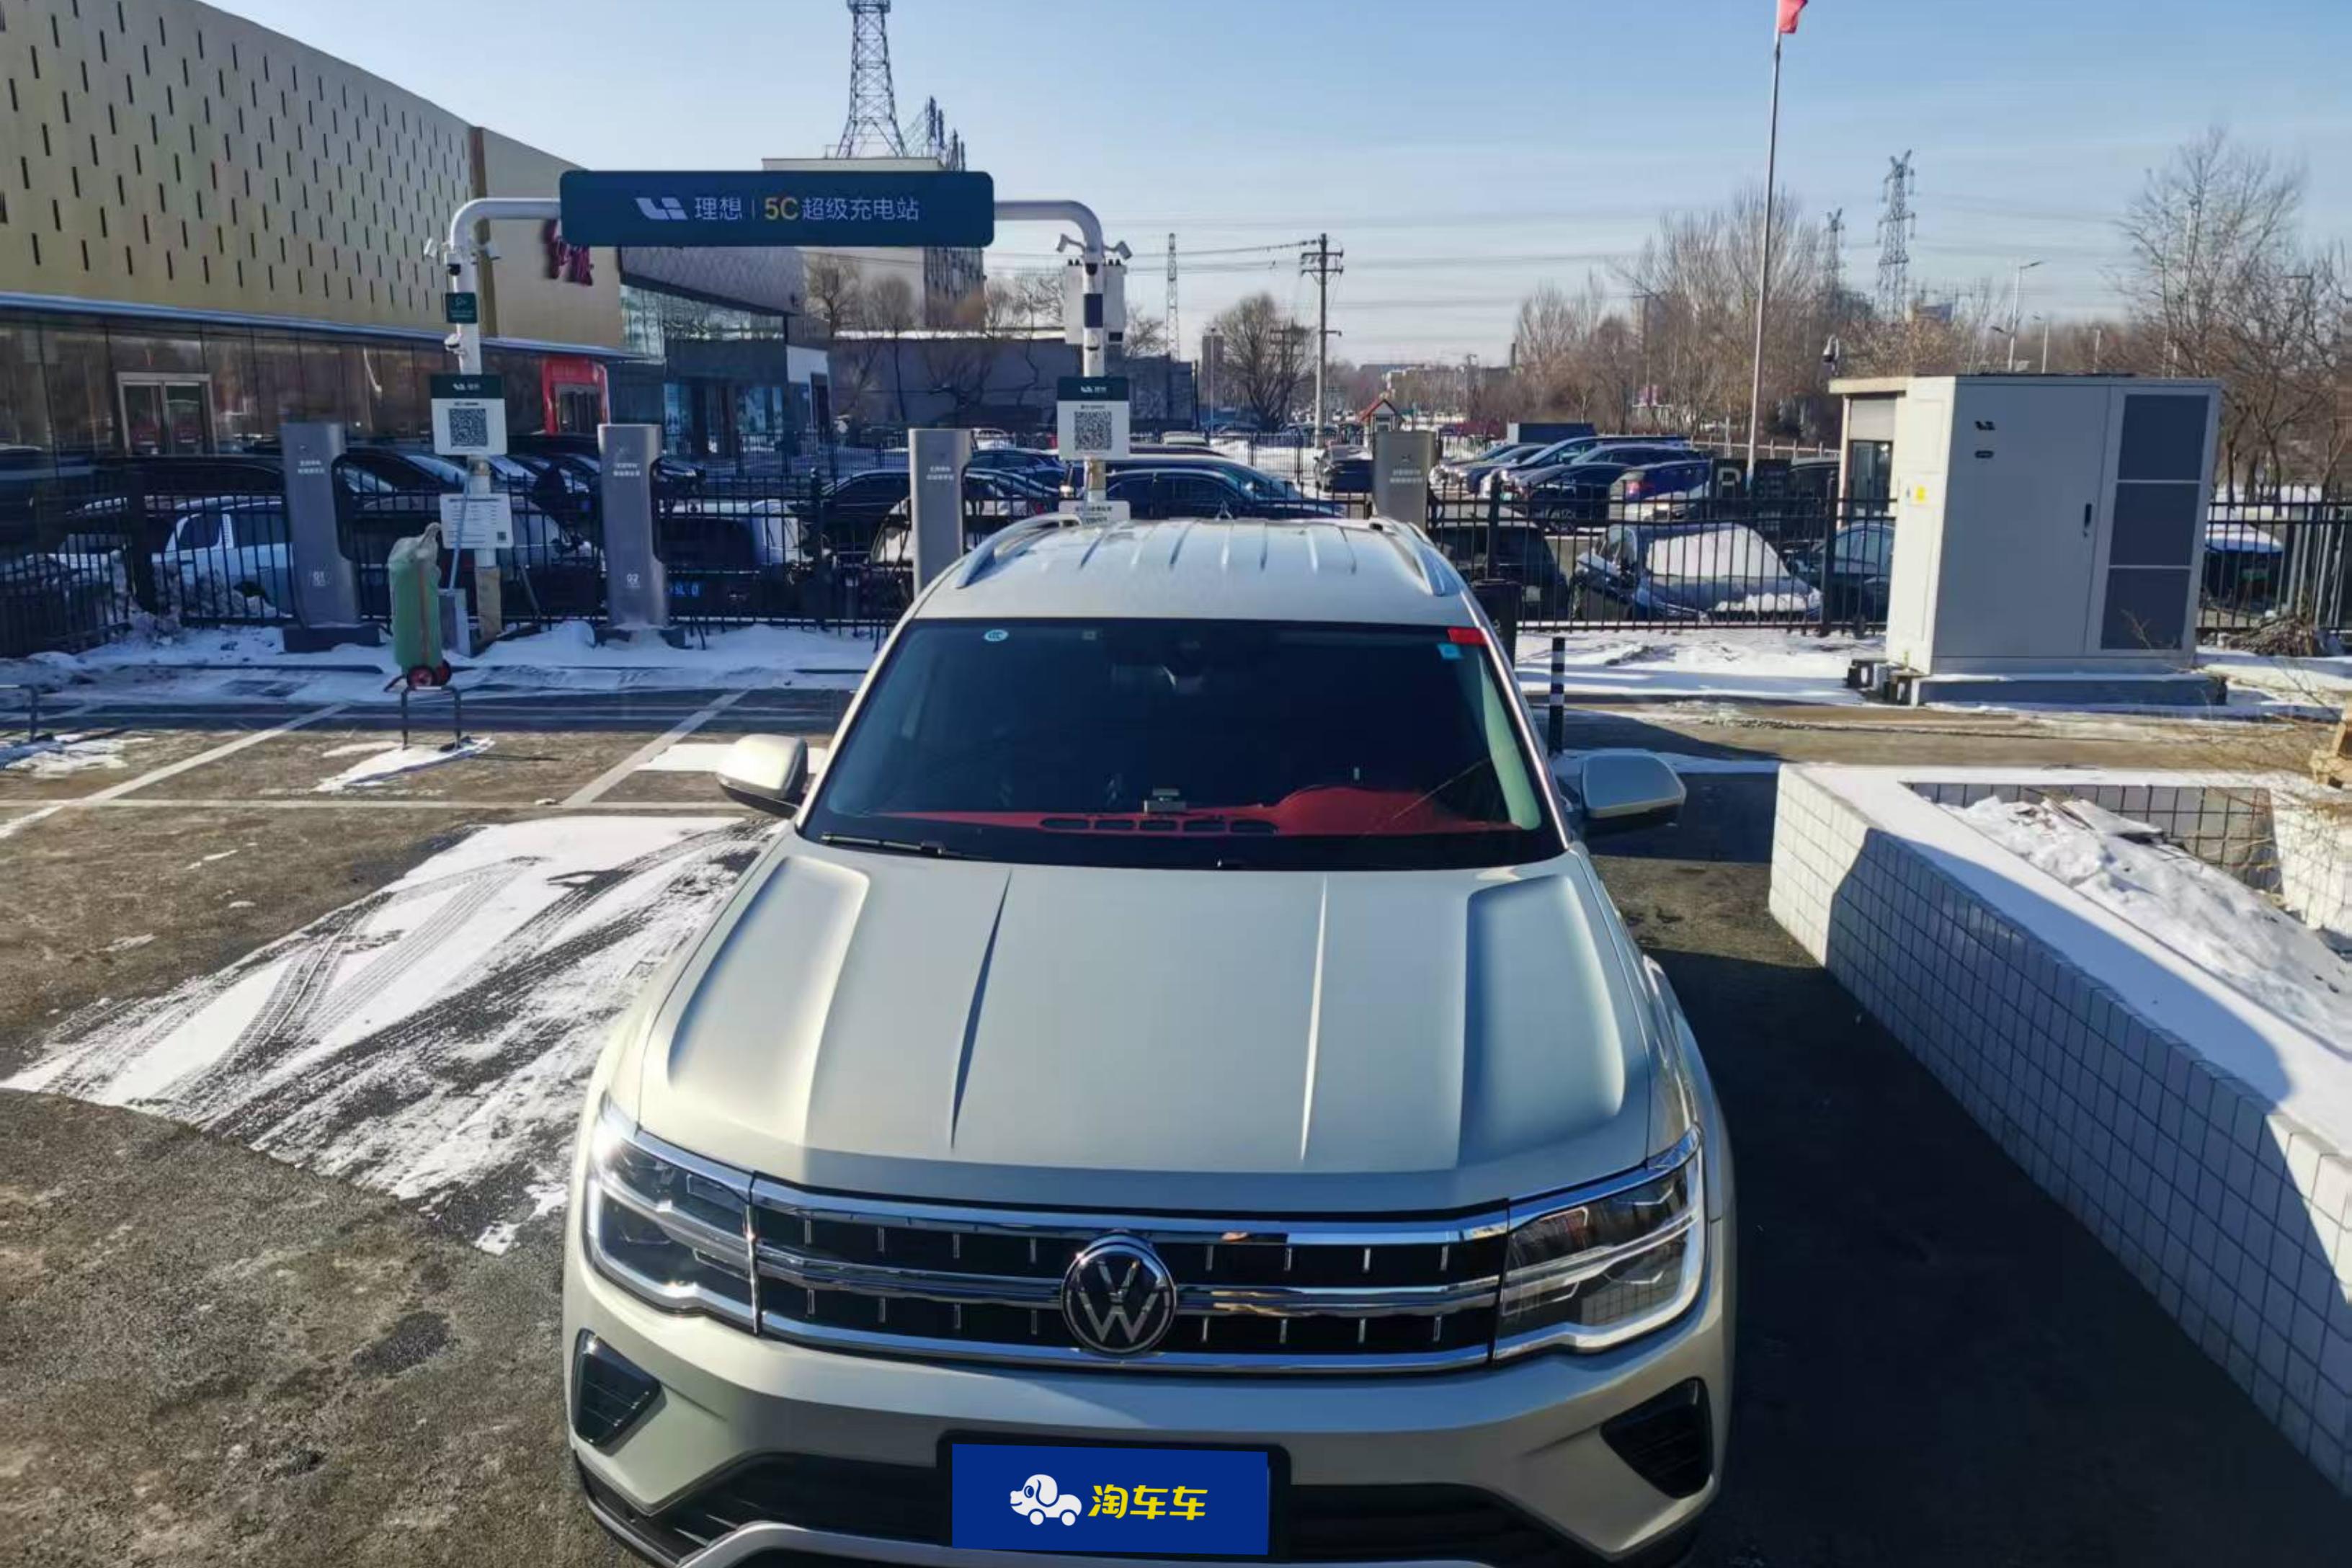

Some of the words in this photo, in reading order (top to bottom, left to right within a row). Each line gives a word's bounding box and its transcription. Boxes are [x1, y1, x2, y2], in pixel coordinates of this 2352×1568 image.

[695, 197, 742, 220] 理想
[765, 197, 919, 221] 5C超级充电站
